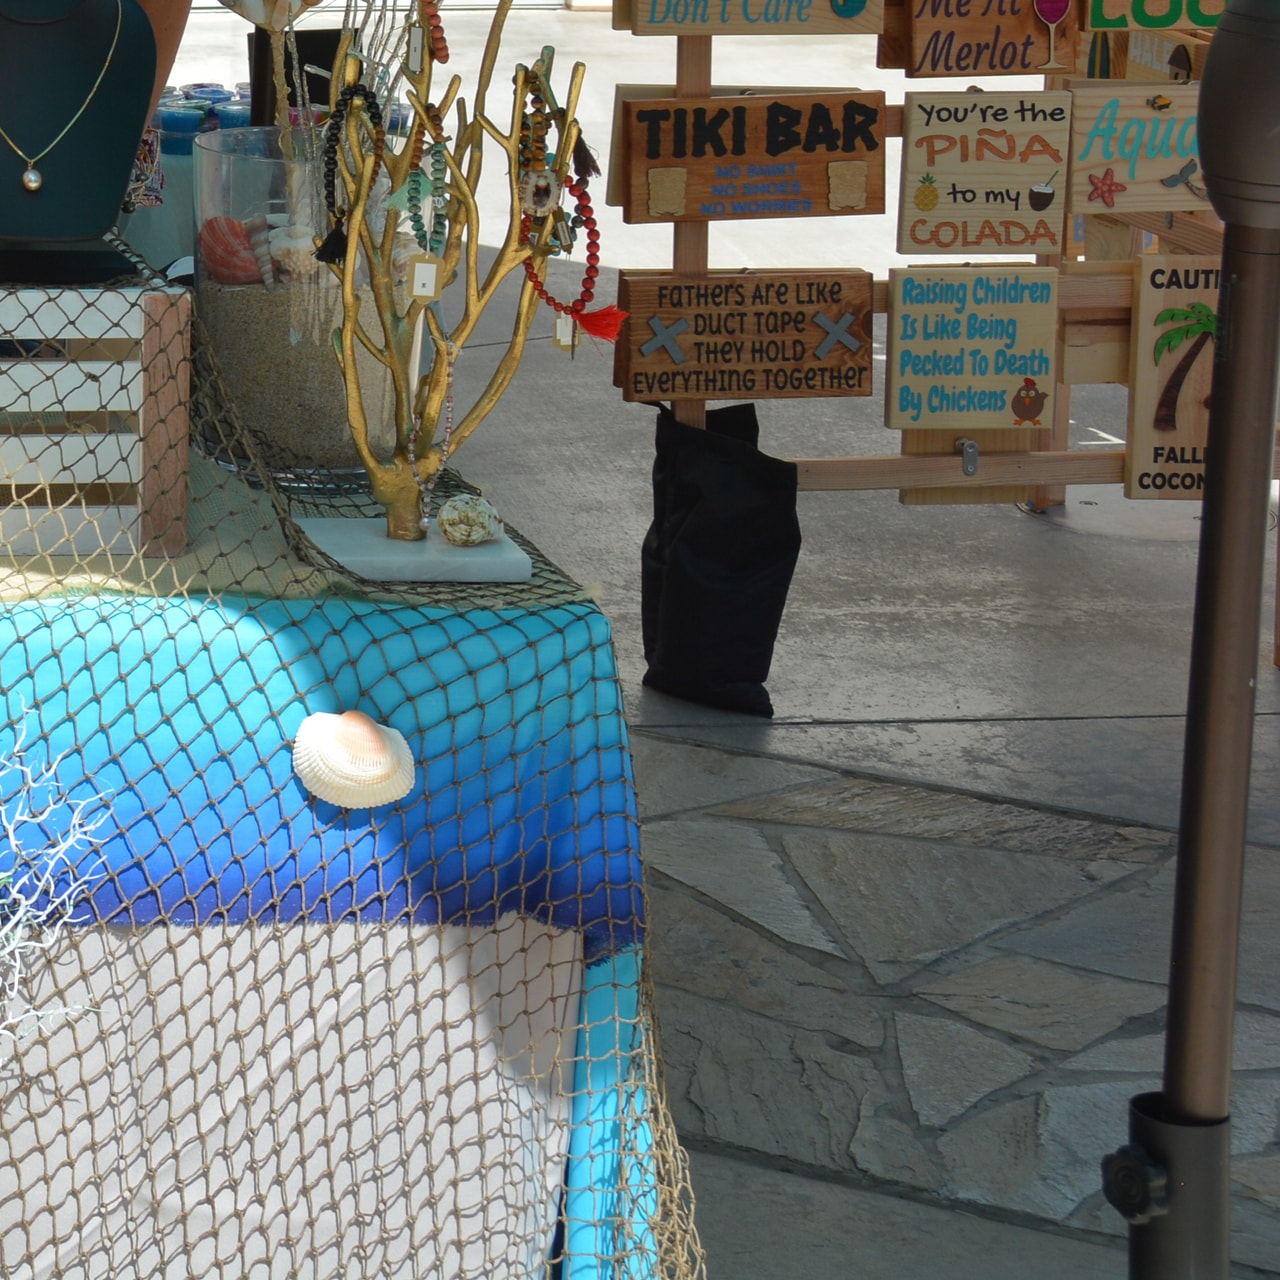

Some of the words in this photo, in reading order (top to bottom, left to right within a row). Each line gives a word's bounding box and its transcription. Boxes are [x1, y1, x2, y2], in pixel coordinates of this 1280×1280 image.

[915, 25, 1035, 71] Merlot
[1013, 100, 1065, 122] the
[636, 106, 747, 159] TIKI
[765, 100, 879, 157] BAR
[915, 129, 1063, 166] PIÑA
[716, 166, 741, 178] NO
[746, 163, 797, 177] SHIRT
[711, 184, 737, 197] NO
[743, 181, 801, 195] SHOES
[947, 183, 976, 204] to
[985, 188, 1020, 211] my
[700, 203, 726, 215] NO
[731, 199, 813, 213] WORRIES
[910, 220, 1057, 247] COLADA
[902, 277, 966, 314] Raising
[972, 276, 1051, 304] Children
[900, 314, 917, 340] Is
[922, 313, 961, 340] Like
[967, 313, 1016, 349] Being
[752, 340, 805, 363] HOLD
[900, 349, 964, 377] Pecked
[969, 349, 989, 376] To
[994, 349, 1049, 376] Death
[899, 386, 921, 421] By
[928, 385, 1007, 413] Chickens
